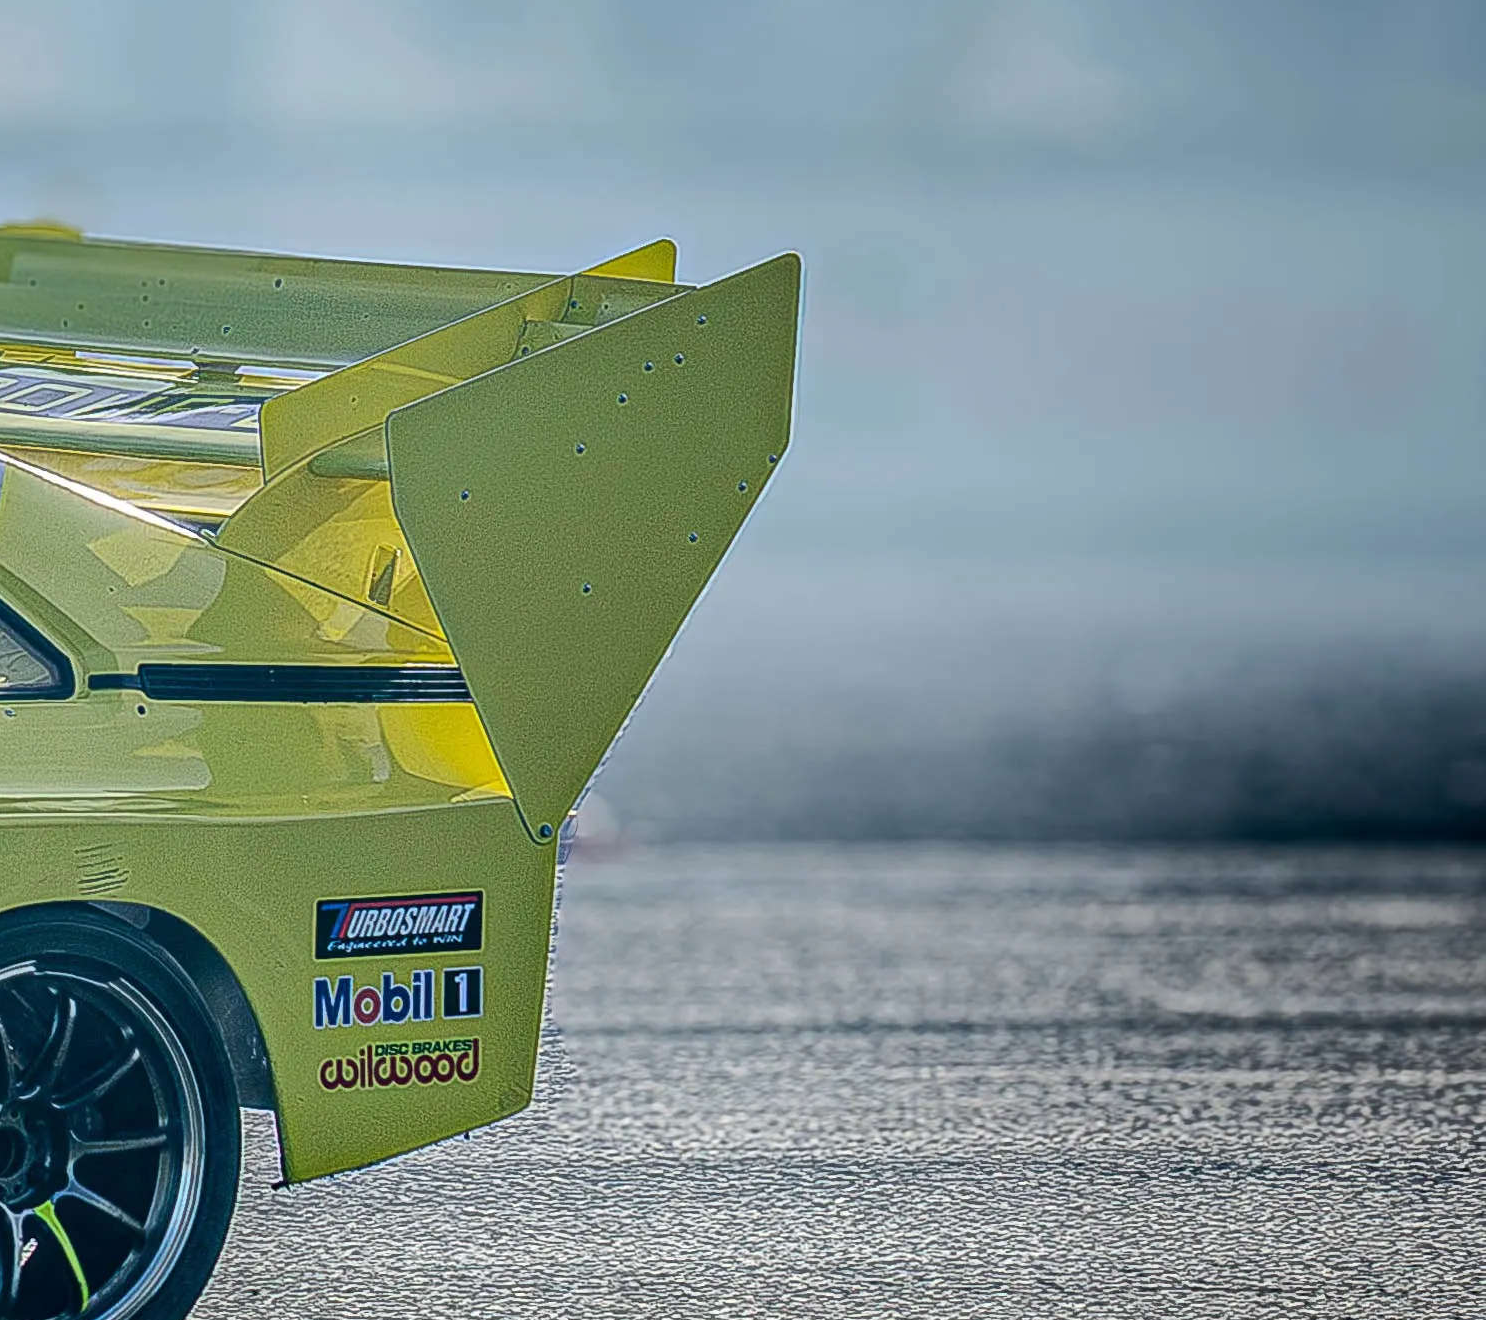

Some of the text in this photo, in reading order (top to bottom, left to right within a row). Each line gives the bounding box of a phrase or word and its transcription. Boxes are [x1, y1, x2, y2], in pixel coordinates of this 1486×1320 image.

[320, 896, 479, 939] TURBOSMART
[313, 969, 435, 1029] Mobil
[319, 1037, 480, 1090] wilwood
[374, 1038, 473, 1057] DISC BRAKES
